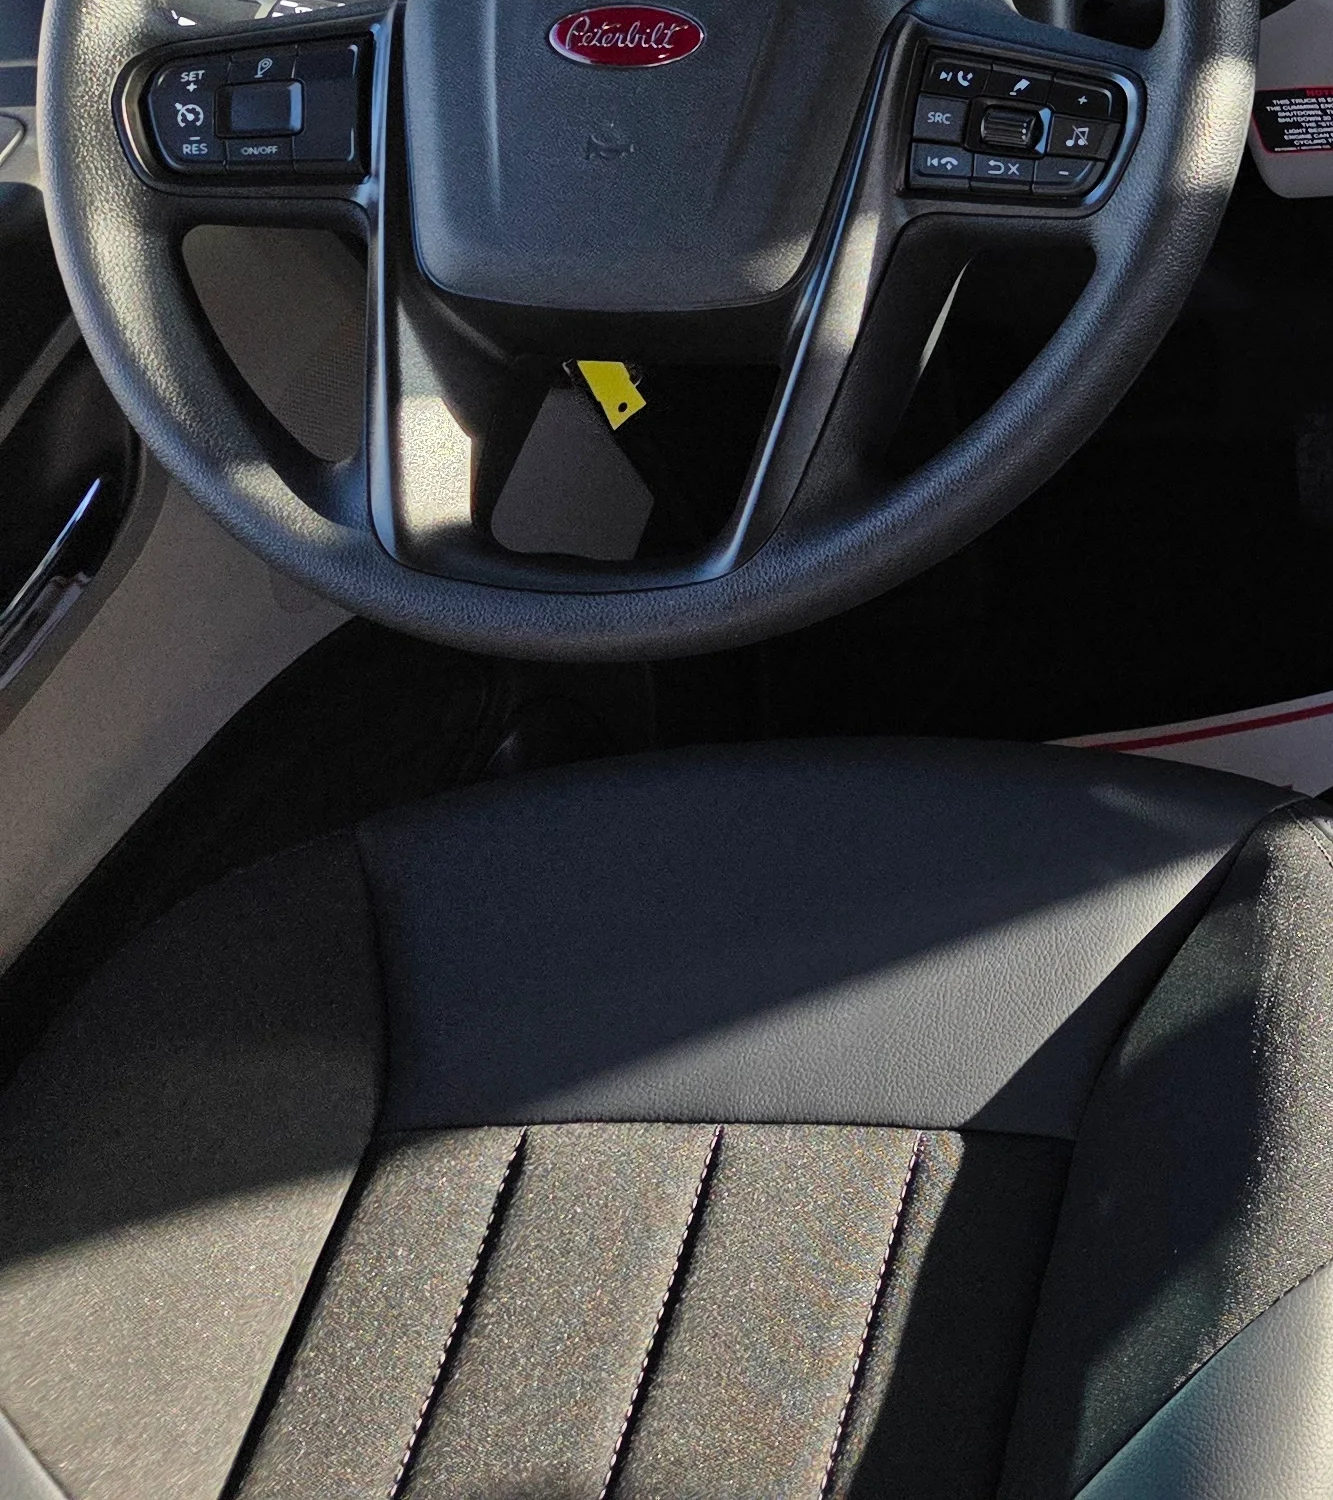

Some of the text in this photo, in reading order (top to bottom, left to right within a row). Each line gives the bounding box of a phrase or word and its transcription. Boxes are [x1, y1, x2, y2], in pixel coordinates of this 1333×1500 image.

[565, 15, 688, 49] Peterbilt
[181, 70, 205, 82] SET
[927, 112, 952, 125] SRC
[182, 143, 208, 154] RES
[241, 146, 278, 155] ON/OFF
